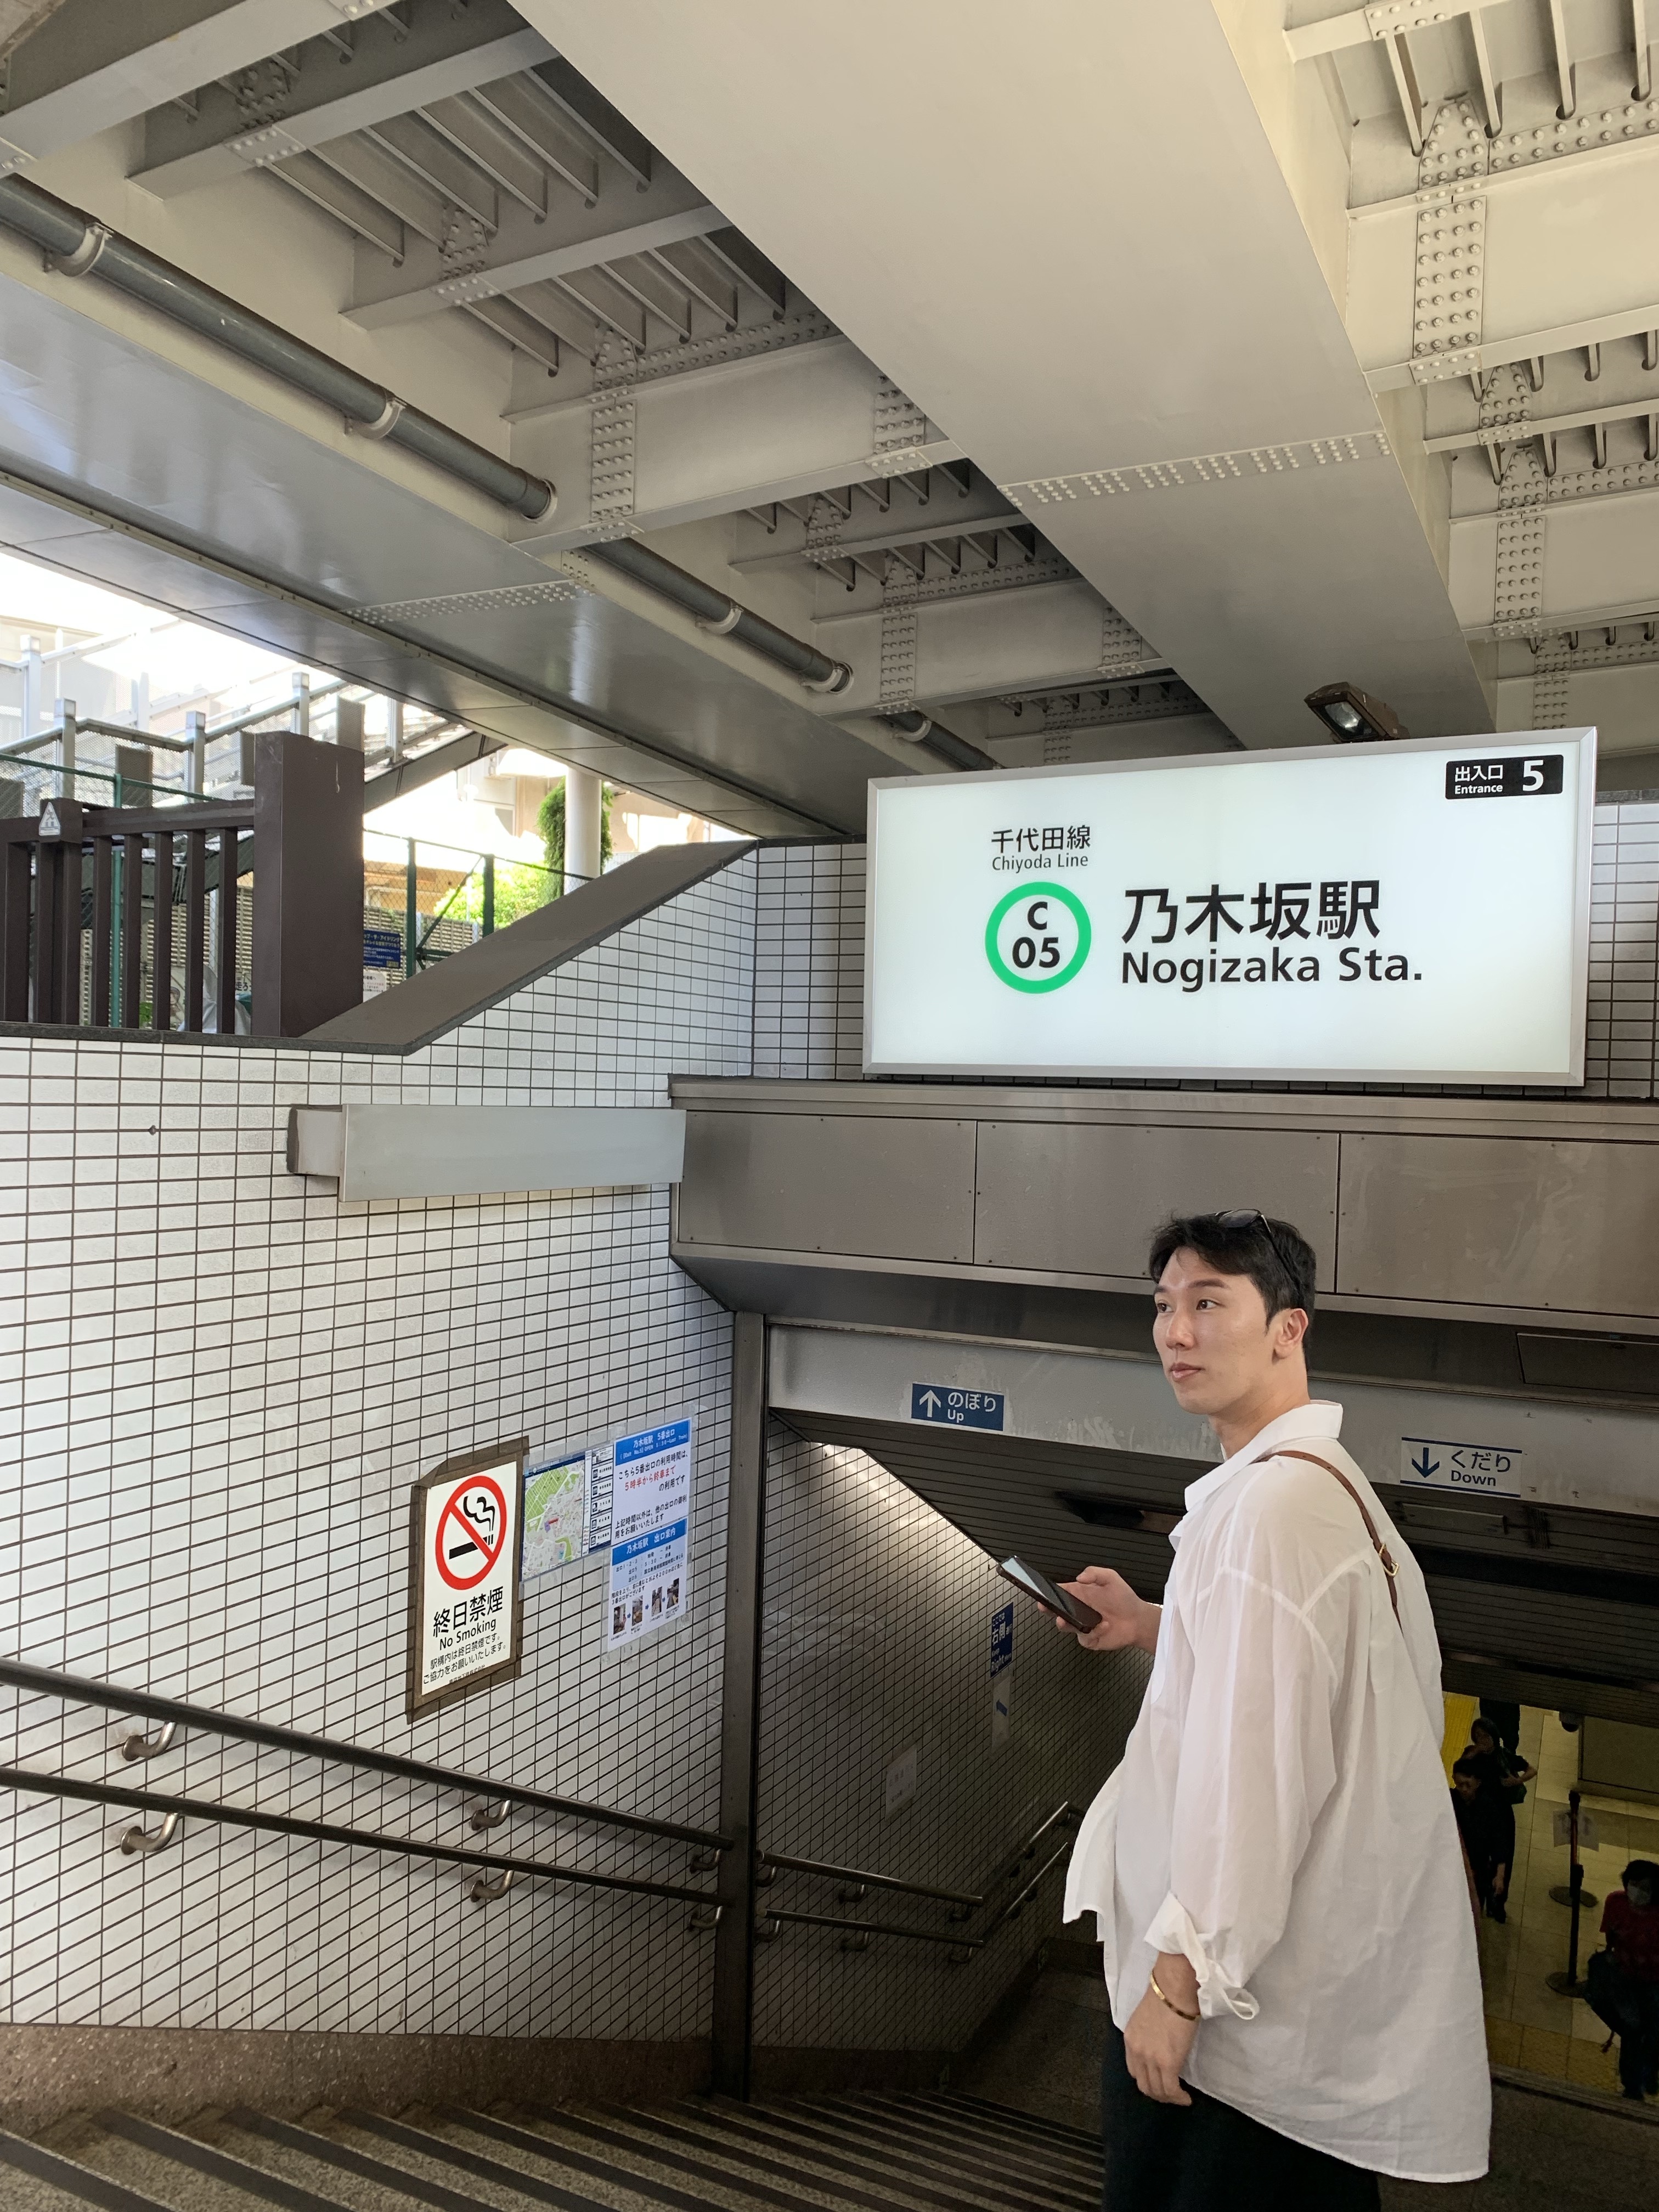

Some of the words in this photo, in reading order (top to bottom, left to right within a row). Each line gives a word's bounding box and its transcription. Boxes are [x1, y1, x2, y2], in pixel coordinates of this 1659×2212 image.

[1454, 764, 1503, 782] 出入口
[1522, 759, 1544, 791] 5
[1454, 785, 1503, 794] Entrance
[991, 825, 1091, 853] 千代田線
[992, 854, 1051, 873] Chiyoda
[1058, 853, 1088, 867] Line
[1028, 901, 1048, 930] C
[1121, 880, 1380, 944] 乃木坂駅
[1012, 936, 1060, 968] 05
[1122, 946, 1319, 992] Nogizaka
[1339, 947, 1422, 981] Sta.
[947, 1392, 996, 1413] のぼり
[947, 1409, 964, 1423] Up
[633, 1435, 653, 1448] 乃木坂駅
[657, 1429, 675, 1441] 5番出口
[1451, 1449, 1511, 1473] くだり
[659, 1475, 686, 1491] の利用です
[1451, 1470, 1496, 1487] Down
[614, 1513, 664, 1539] 用をお願いいたします
[627, 1538, 648, 1554] 乃木坂駅
[654, 1527, 676, 1543] 出口案内
[433, 1586, 503, 1638] 終日禁煙
[439, 1637, 453, 1650] No
[456, 1618, 496, 1644] Smoking
[424, 1641, 506, 1684] ご協力をお願いいたします。
[431, 1633, 500, 1669] 駅構内は終日禁煙です。
[991, 1655, 1004, 1672] Right
